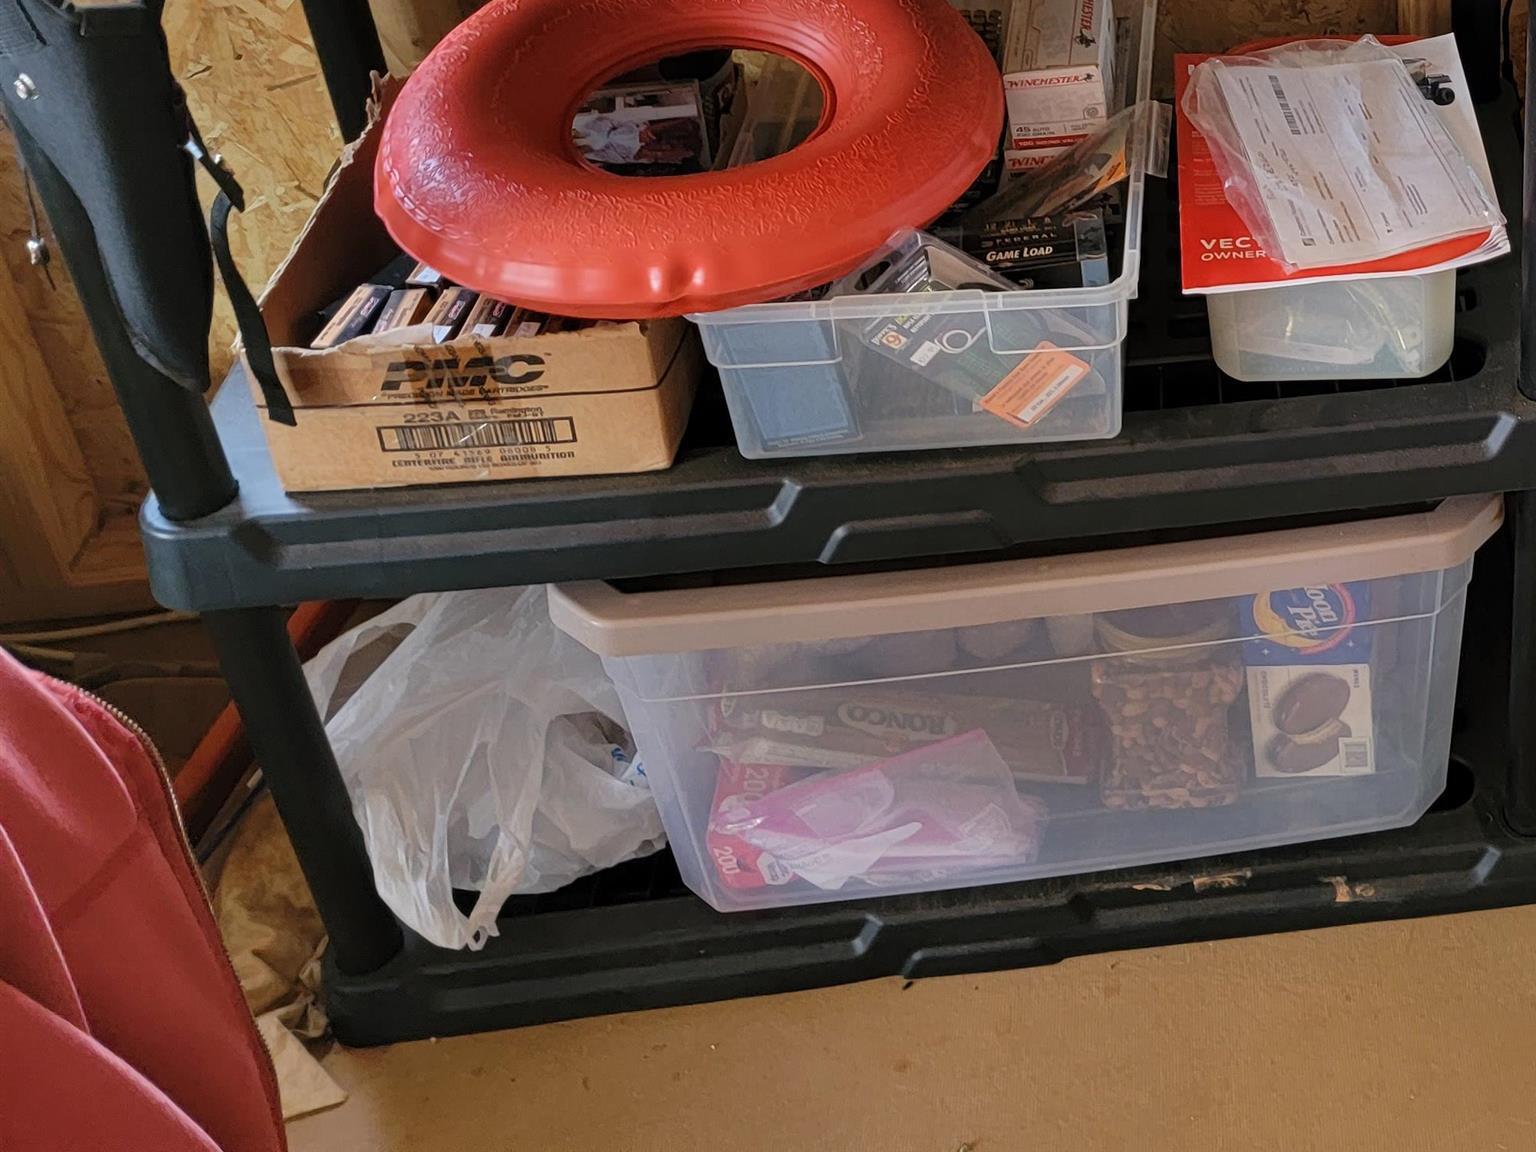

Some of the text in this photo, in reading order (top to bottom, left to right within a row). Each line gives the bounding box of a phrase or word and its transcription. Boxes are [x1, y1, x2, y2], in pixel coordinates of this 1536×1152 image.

[1007, 75, 1082, 89] WINCHESTER
[986, 246, 1054, 262] GAME LOAD
[380, 354, 546, 392] PMC
[402, 411, 460, 424] 223A
